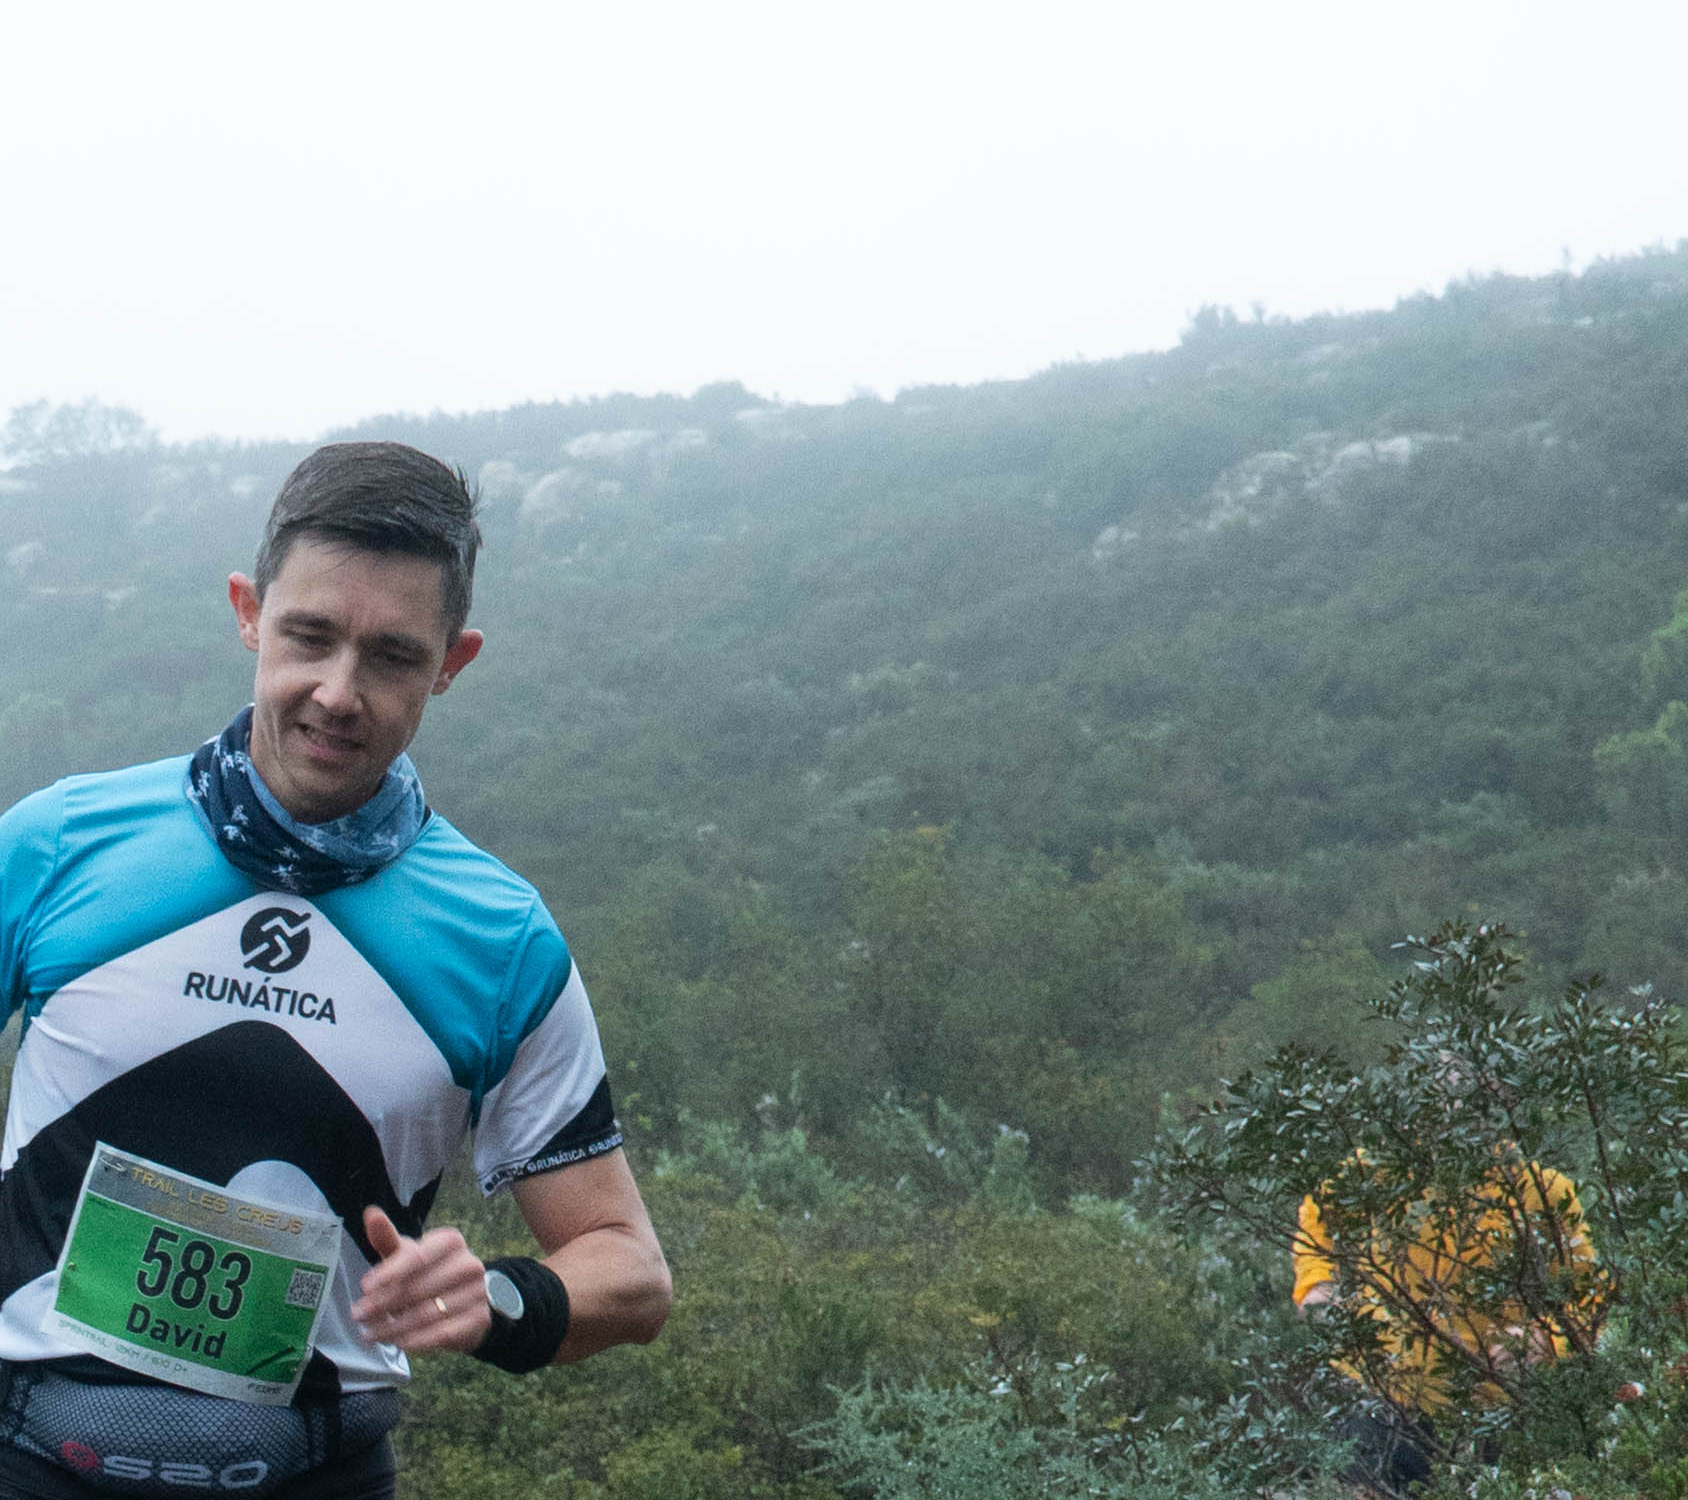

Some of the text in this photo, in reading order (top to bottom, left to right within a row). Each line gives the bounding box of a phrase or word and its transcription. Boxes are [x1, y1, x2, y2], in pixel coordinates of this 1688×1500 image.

[183, 971, 337, 1025] RUNÁTICA
[131, 1166, 180, 1198] TRAIL
[187, 1189, 229, 1214] LES
[135, 1225, 252, 1321] 583
[125, 1302, 227, 1359] David
